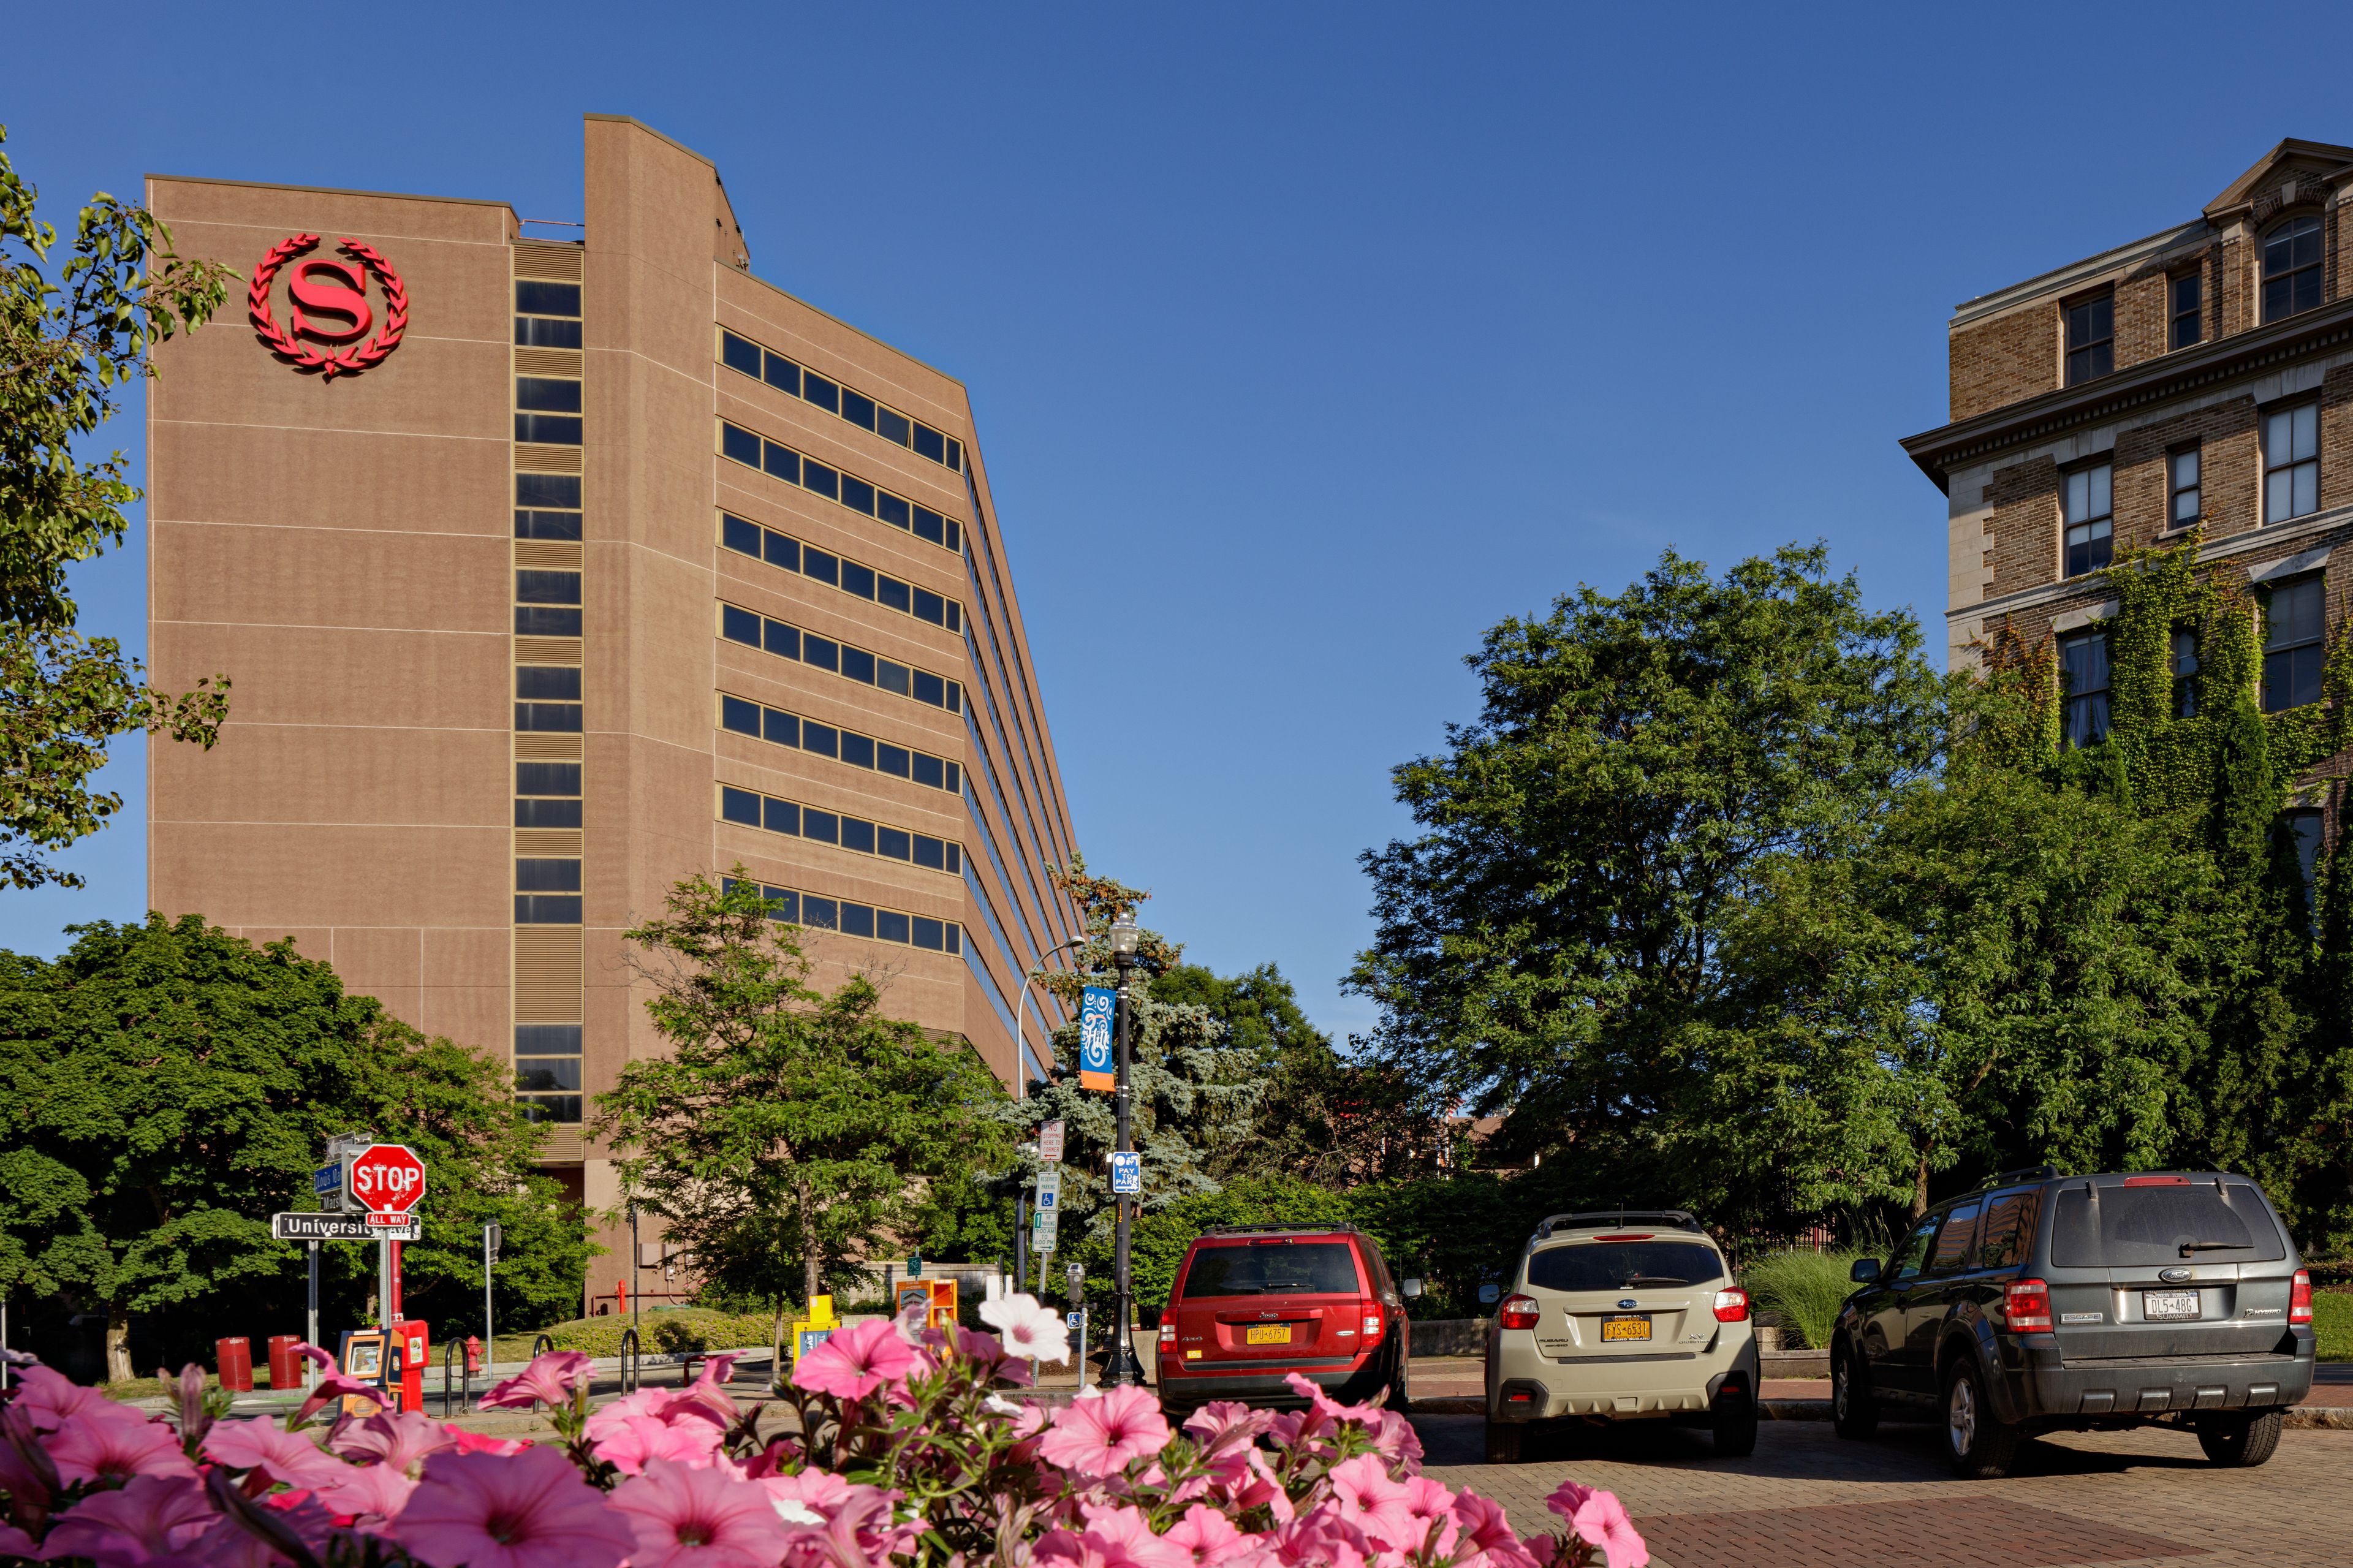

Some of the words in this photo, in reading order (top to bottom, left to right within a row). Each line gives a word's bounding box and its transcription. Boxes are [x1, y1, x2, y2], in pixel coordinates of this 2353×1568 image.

[290, 259, 373, 341] S
[317, 1172, 331, 1188] Louis
[357, 1165, 419, 1191] STOP
[289, 1218, 378, 1237] University
[369, 1215, 385, 1224] ALL
[390, 1215, 407, 1224] WAY
[1036, 1214, 1040, 1227] 1
